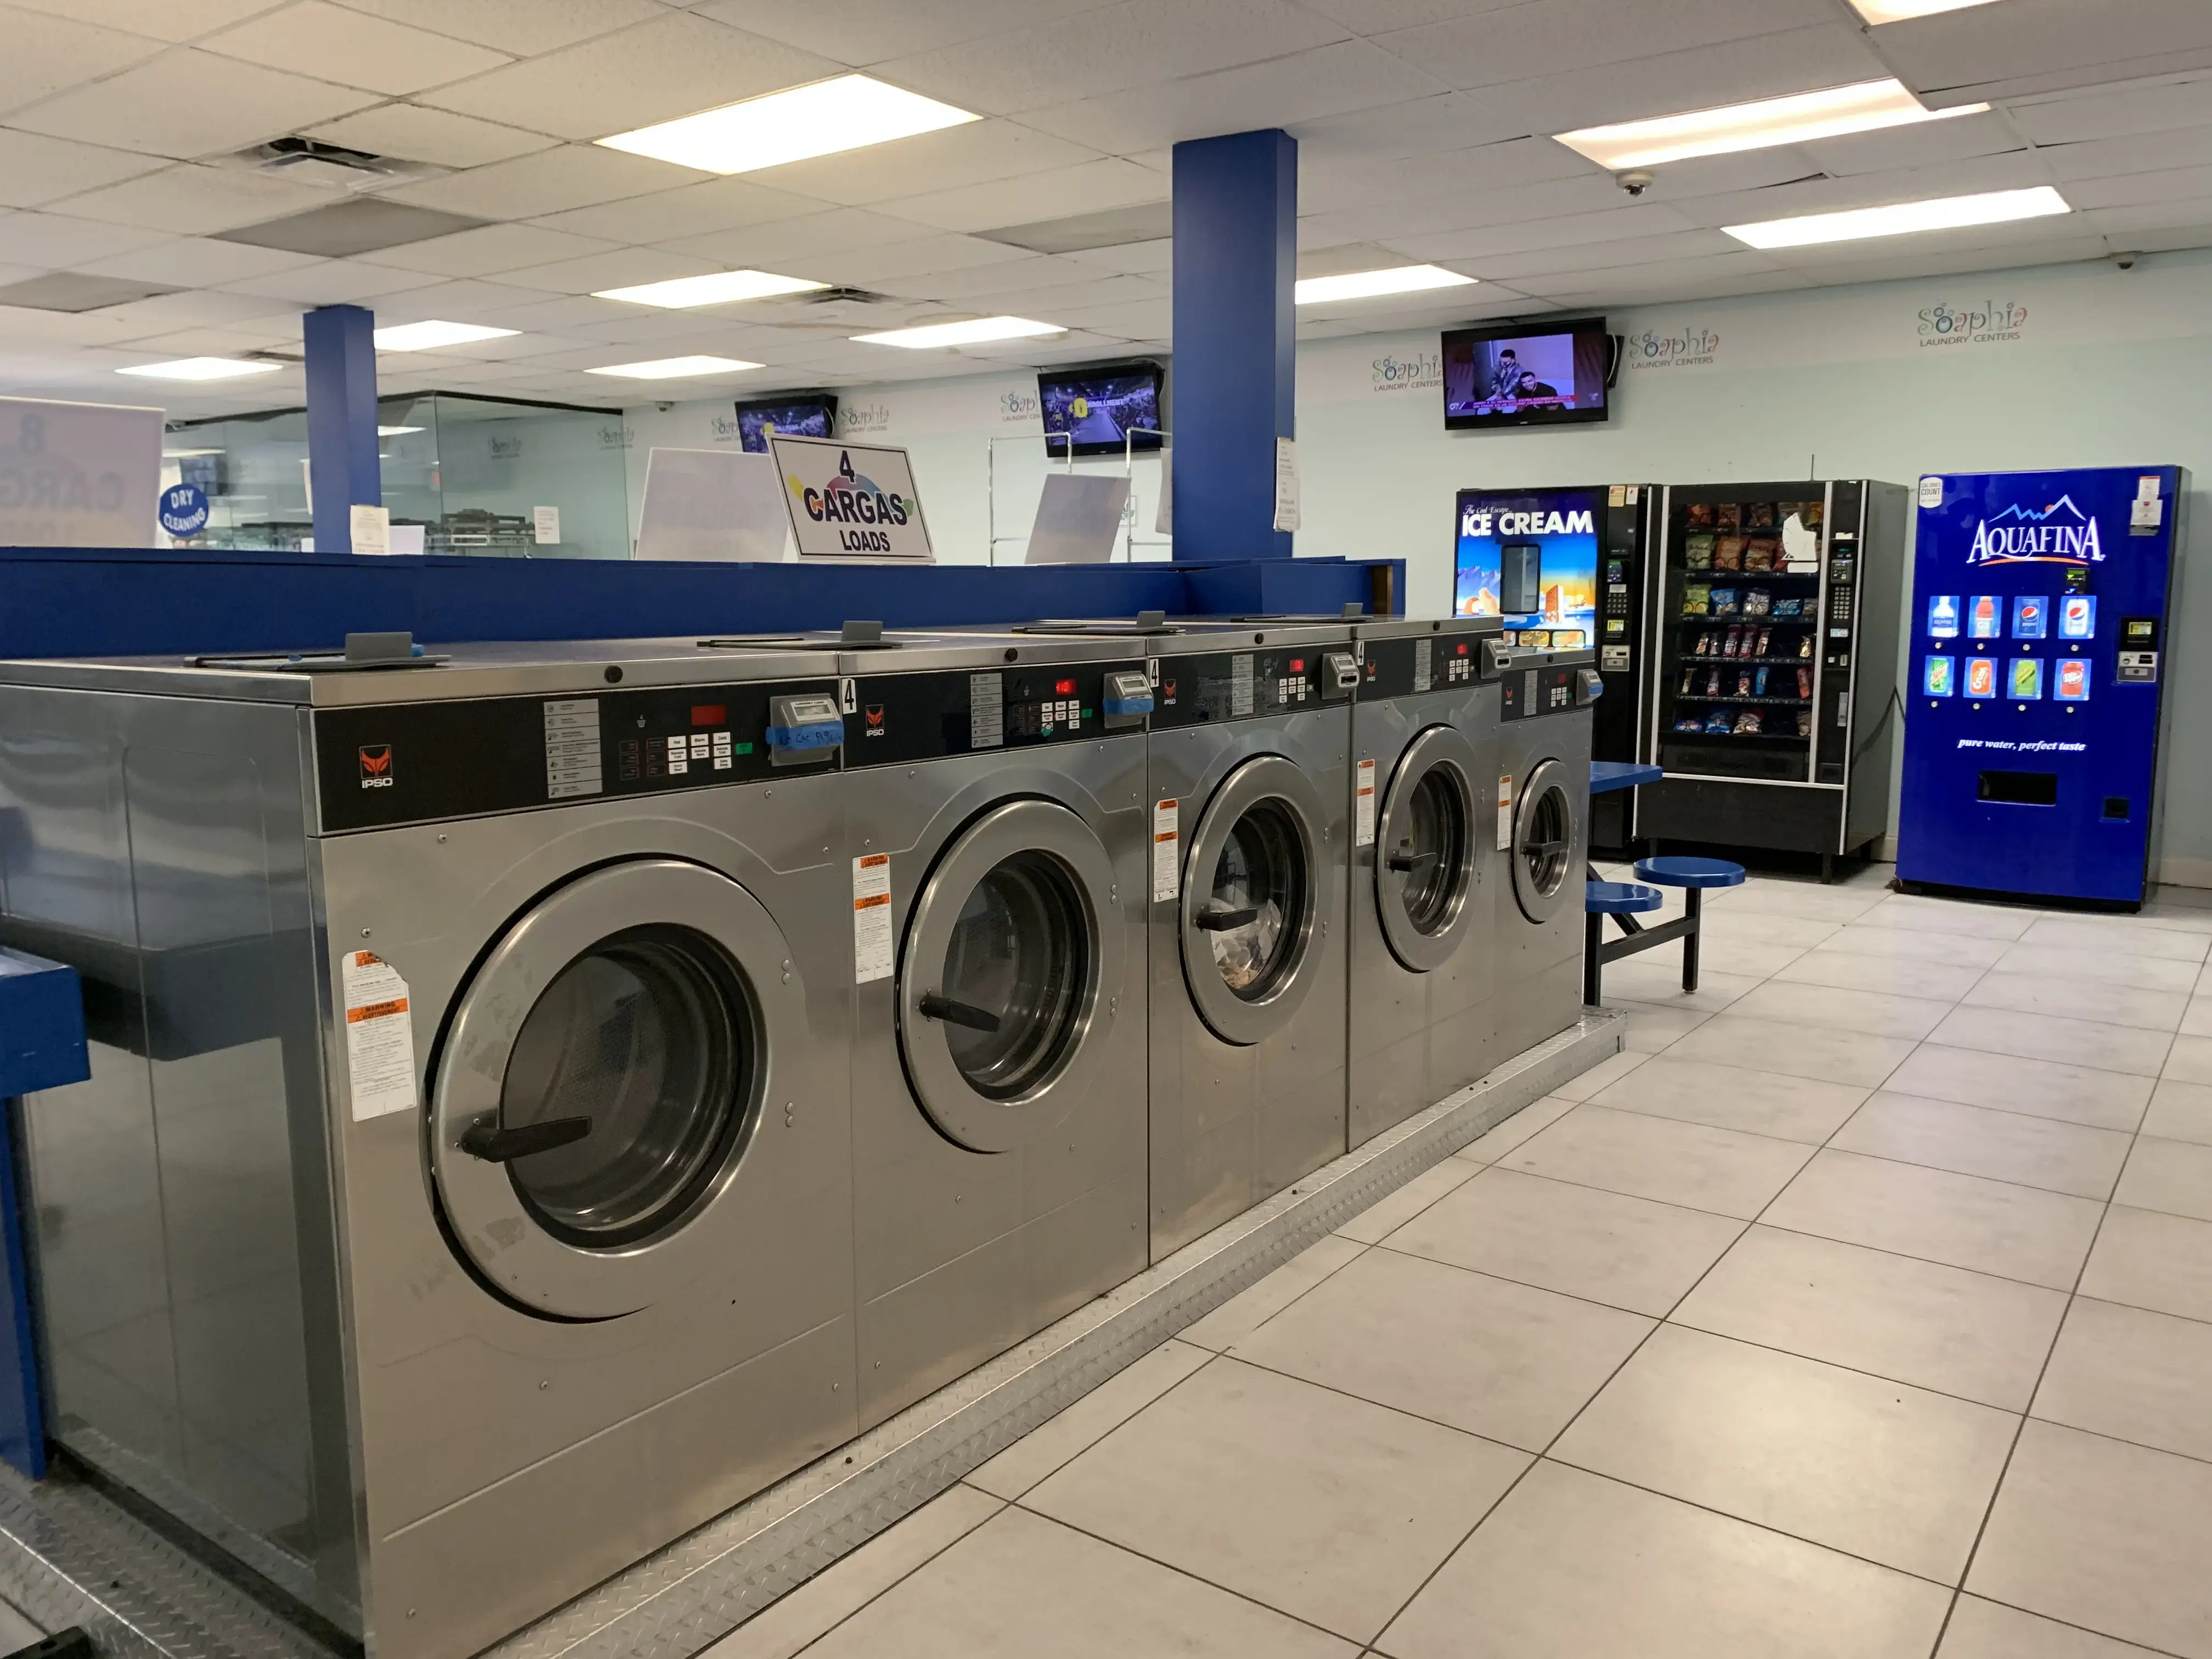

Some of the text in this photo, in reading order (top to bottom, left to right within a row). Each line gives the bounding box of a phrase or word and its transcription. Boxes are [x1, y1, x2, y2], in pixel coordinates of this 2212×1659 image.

[1917, 300, 2027, 336] Soaphia
[1629, 328, 1719, 360] Soaphia
[1920, 332, 2021, 347] LAUNDRY CENTERS
[1632, 357, 1714, 369] LAUNDRY CENTERS
[1374, 380, 1443, 392] LAUNDRY CENTERS
[839, 450, 855, 482] 4
[171, 489, 194, 509] DRY
[804, 487, 907, 526] CARGAS
[163, 507, 206, 532] CLEANING
[1476, 506, 1487, 514] Cool
[1462, 511, 1594, 537] ICE CREAM
[839, 530, 890, 552] LOADS
[1966, 516, 2104, 563] AQUAFINA
[1359, 643, 1363, 663] 4
[1152, 661, 1157, 685] 4
[845, 680, 854, 710] 4
[867, 729, 884, 737] IPSO
[1957, 739, 2086, 752] pure water, perfect taste
[362, 777, 393, 789] IPSO
[365, 1002, 395, 1012] WARNING
